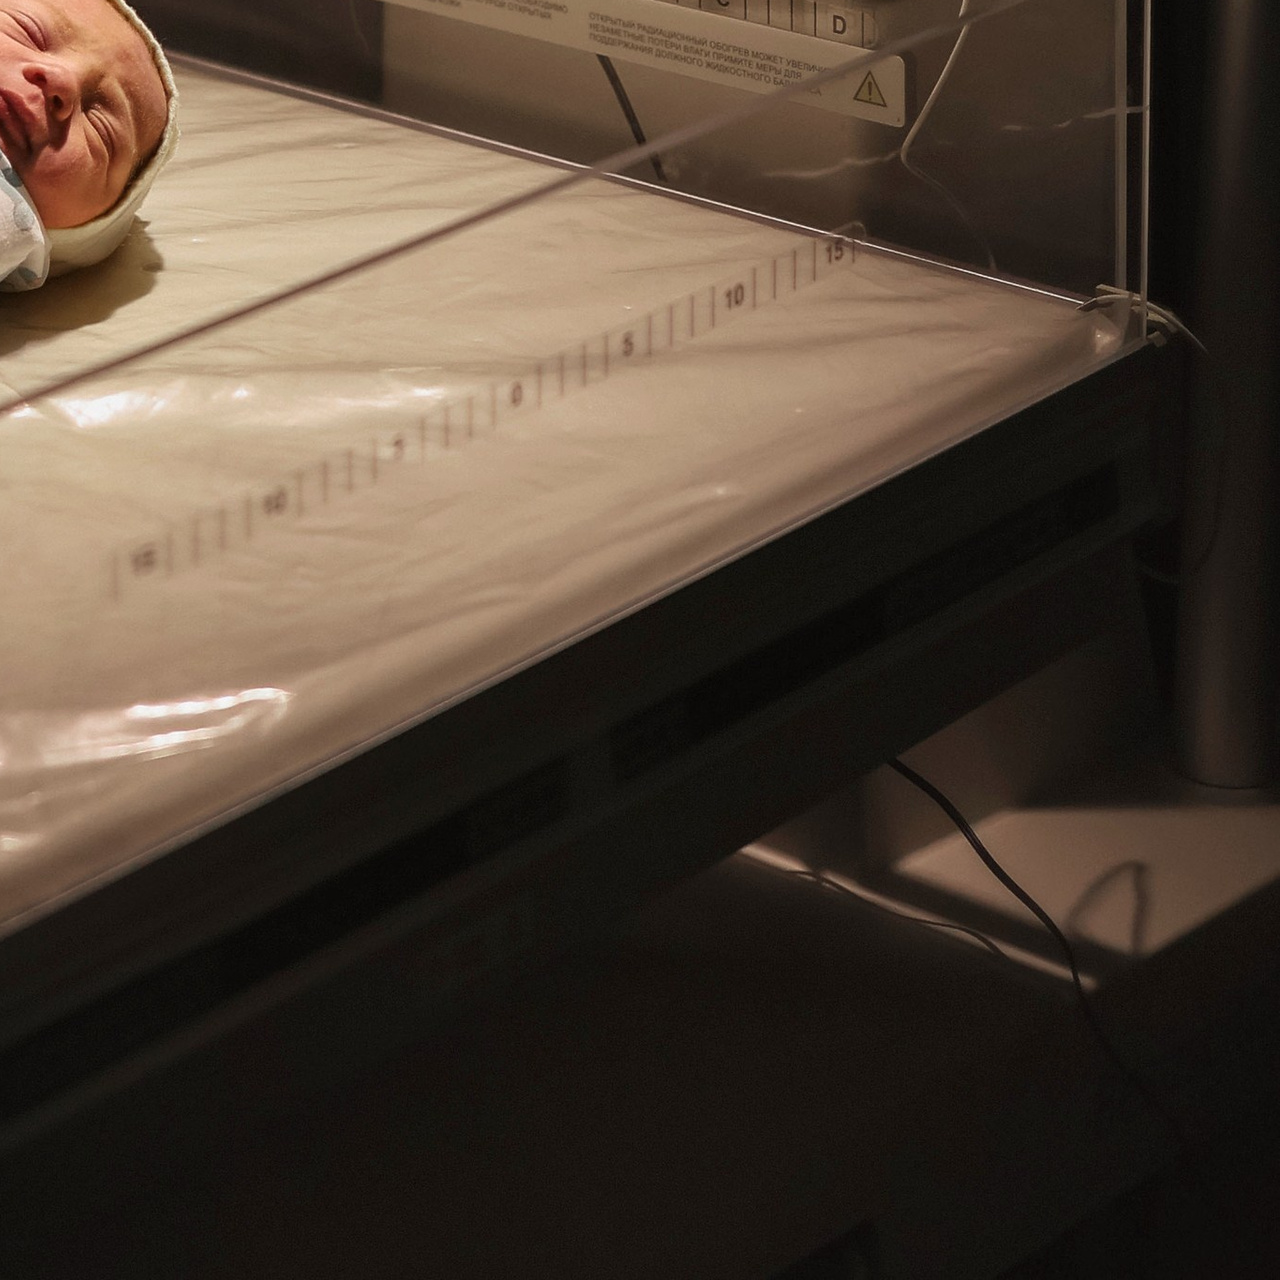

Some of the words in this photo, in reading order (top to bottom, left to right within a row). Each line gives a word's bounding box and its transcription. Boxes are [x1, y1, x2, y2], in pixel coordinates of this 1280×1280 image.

[833, 14, 847, 35] D
[589, 23, 646, 42] НЕЗАМЕТНЫЕ
[648, 35, 681, 51] ПОТЕРИ
[712, 51, 754, 69] ПРИМИТЕ
[756, 62, 782, 76] МЕРЫ
[783, 68, 802, 80] ДЛЯ
[589, 32, 653, 55] ПОДДЕРЖАНИЯ
[655, 47, 704, 67] ДОЛЖНОГО
[706, 60, 771, 84] ЖИДКОСТНОГО
[710, 40, 749, 57] ОБОГРЕВ
[751, 50, 784, 64] МОЖЕТ
[511, 380, 524, 408] 0
[726, 283, 744, 311] 10
[826, 241, 845, 265] 15
